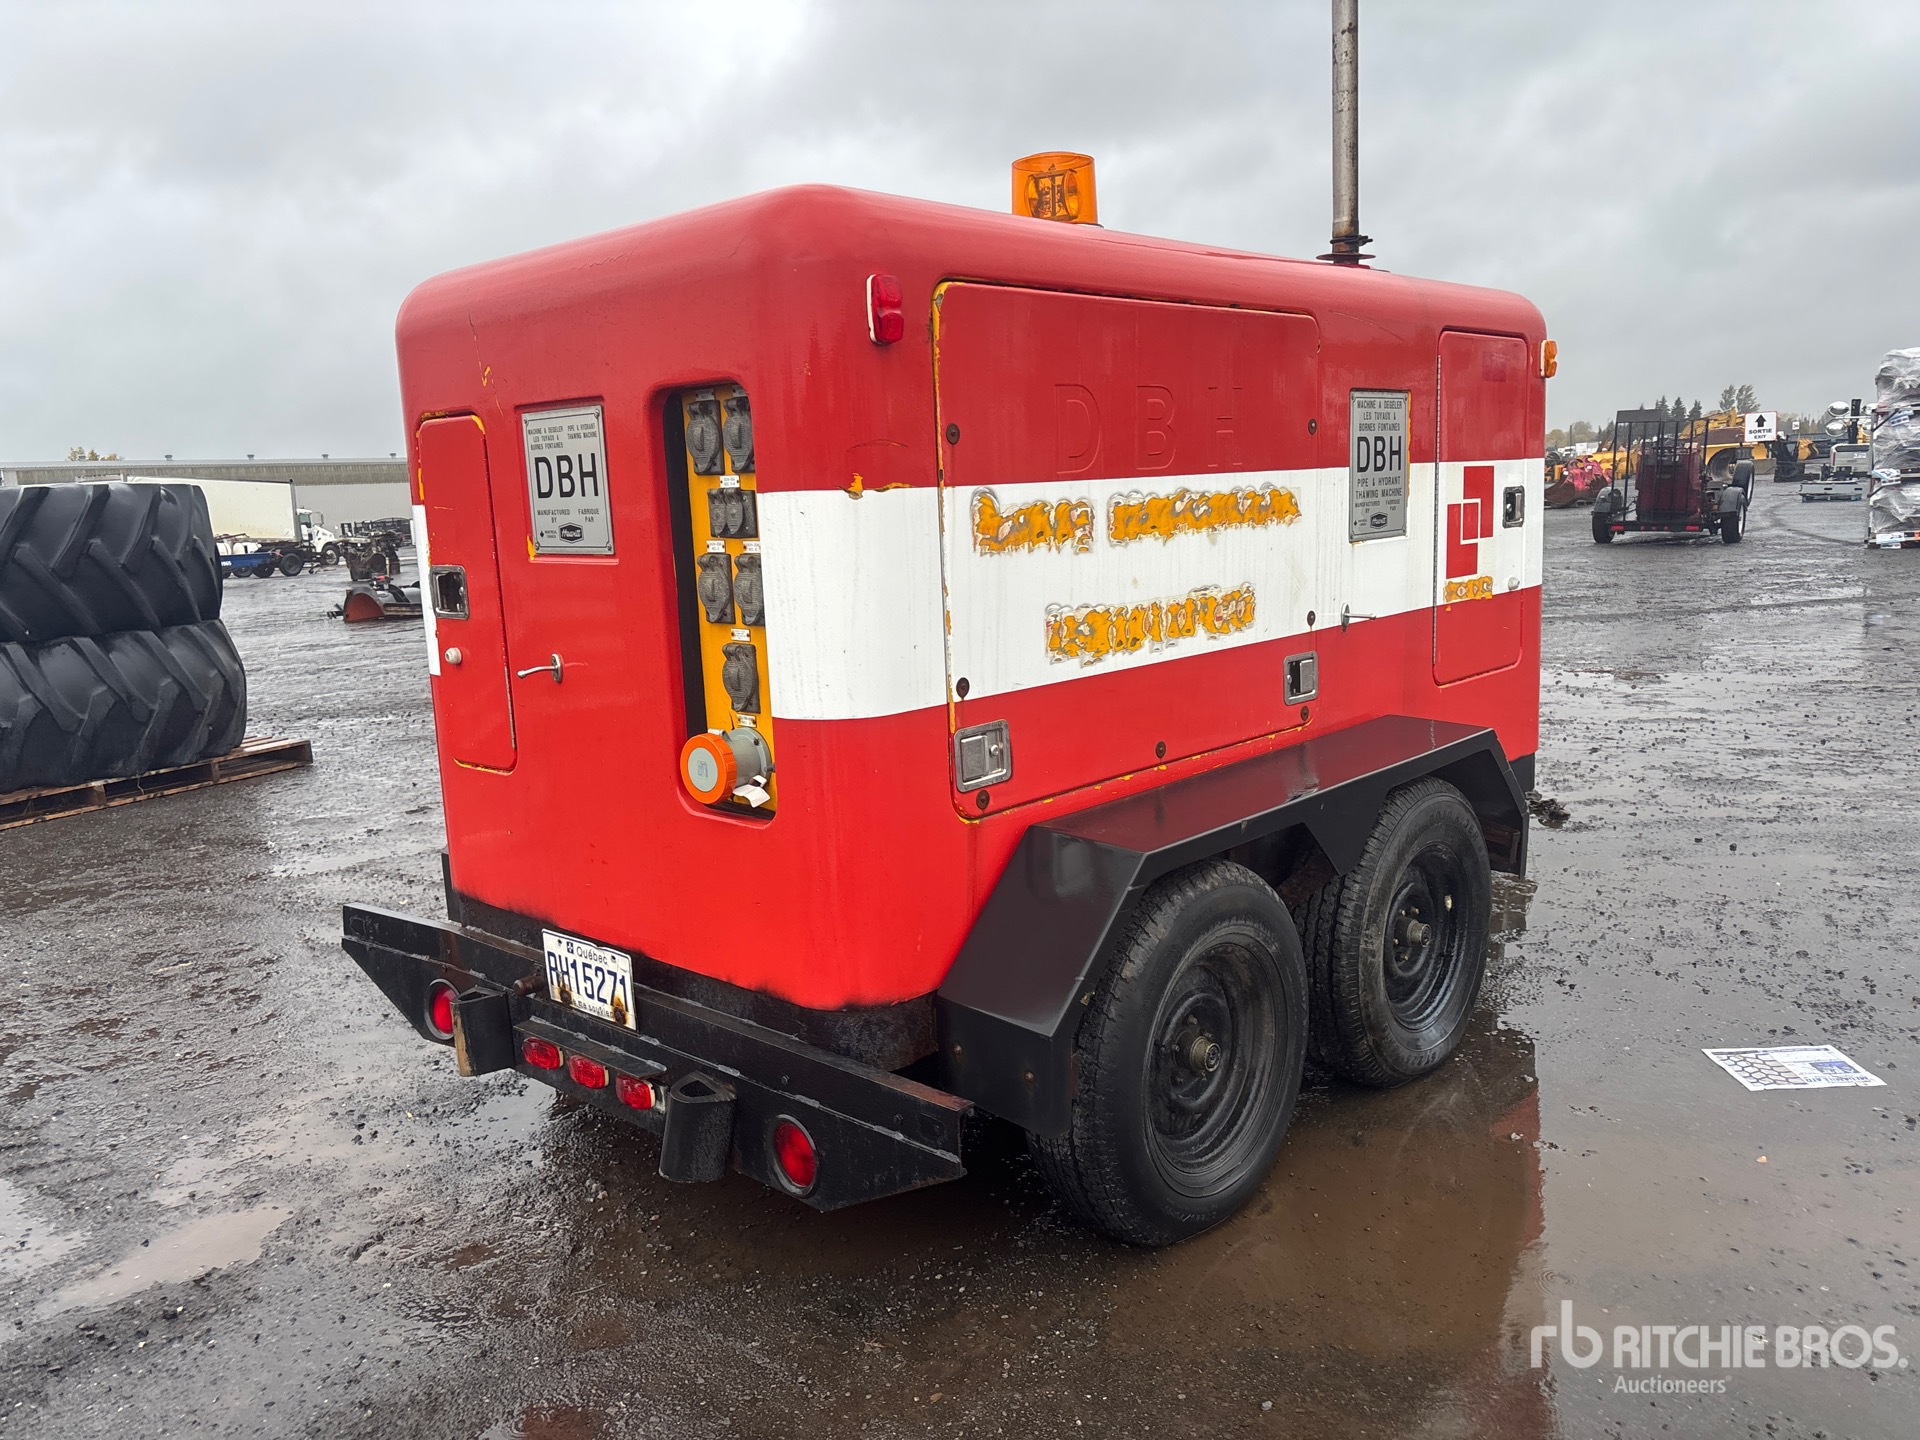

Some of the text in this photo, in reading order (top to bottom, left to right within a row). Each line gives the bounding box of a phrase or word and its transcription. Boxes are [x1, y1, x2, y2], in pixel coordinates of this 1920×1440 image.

[1356, 400, 1376, 409] MACHINE
[1384, 400, 1402, 409] DEGELER
[1363, 411, 1371, 420] LES
[1374, 411, 1391, 420] TUYAUX
[567, 424, 575, 432] PIPE
[1359, 423, 1400, 431] BORNES FONTAINES
[1357, 435, 1402, 473] DBH
[534, 453, 599, 499] DBH
[1357, 477, 1368, 487] PIPE
[1378, 476, 1400, 486] HYDRANT
[1355, 487, 1402, 499] THAWING MACHINE
[537, 508, 570, 516] MANUFACTURED
[576, 946, 609, 966] Québec
